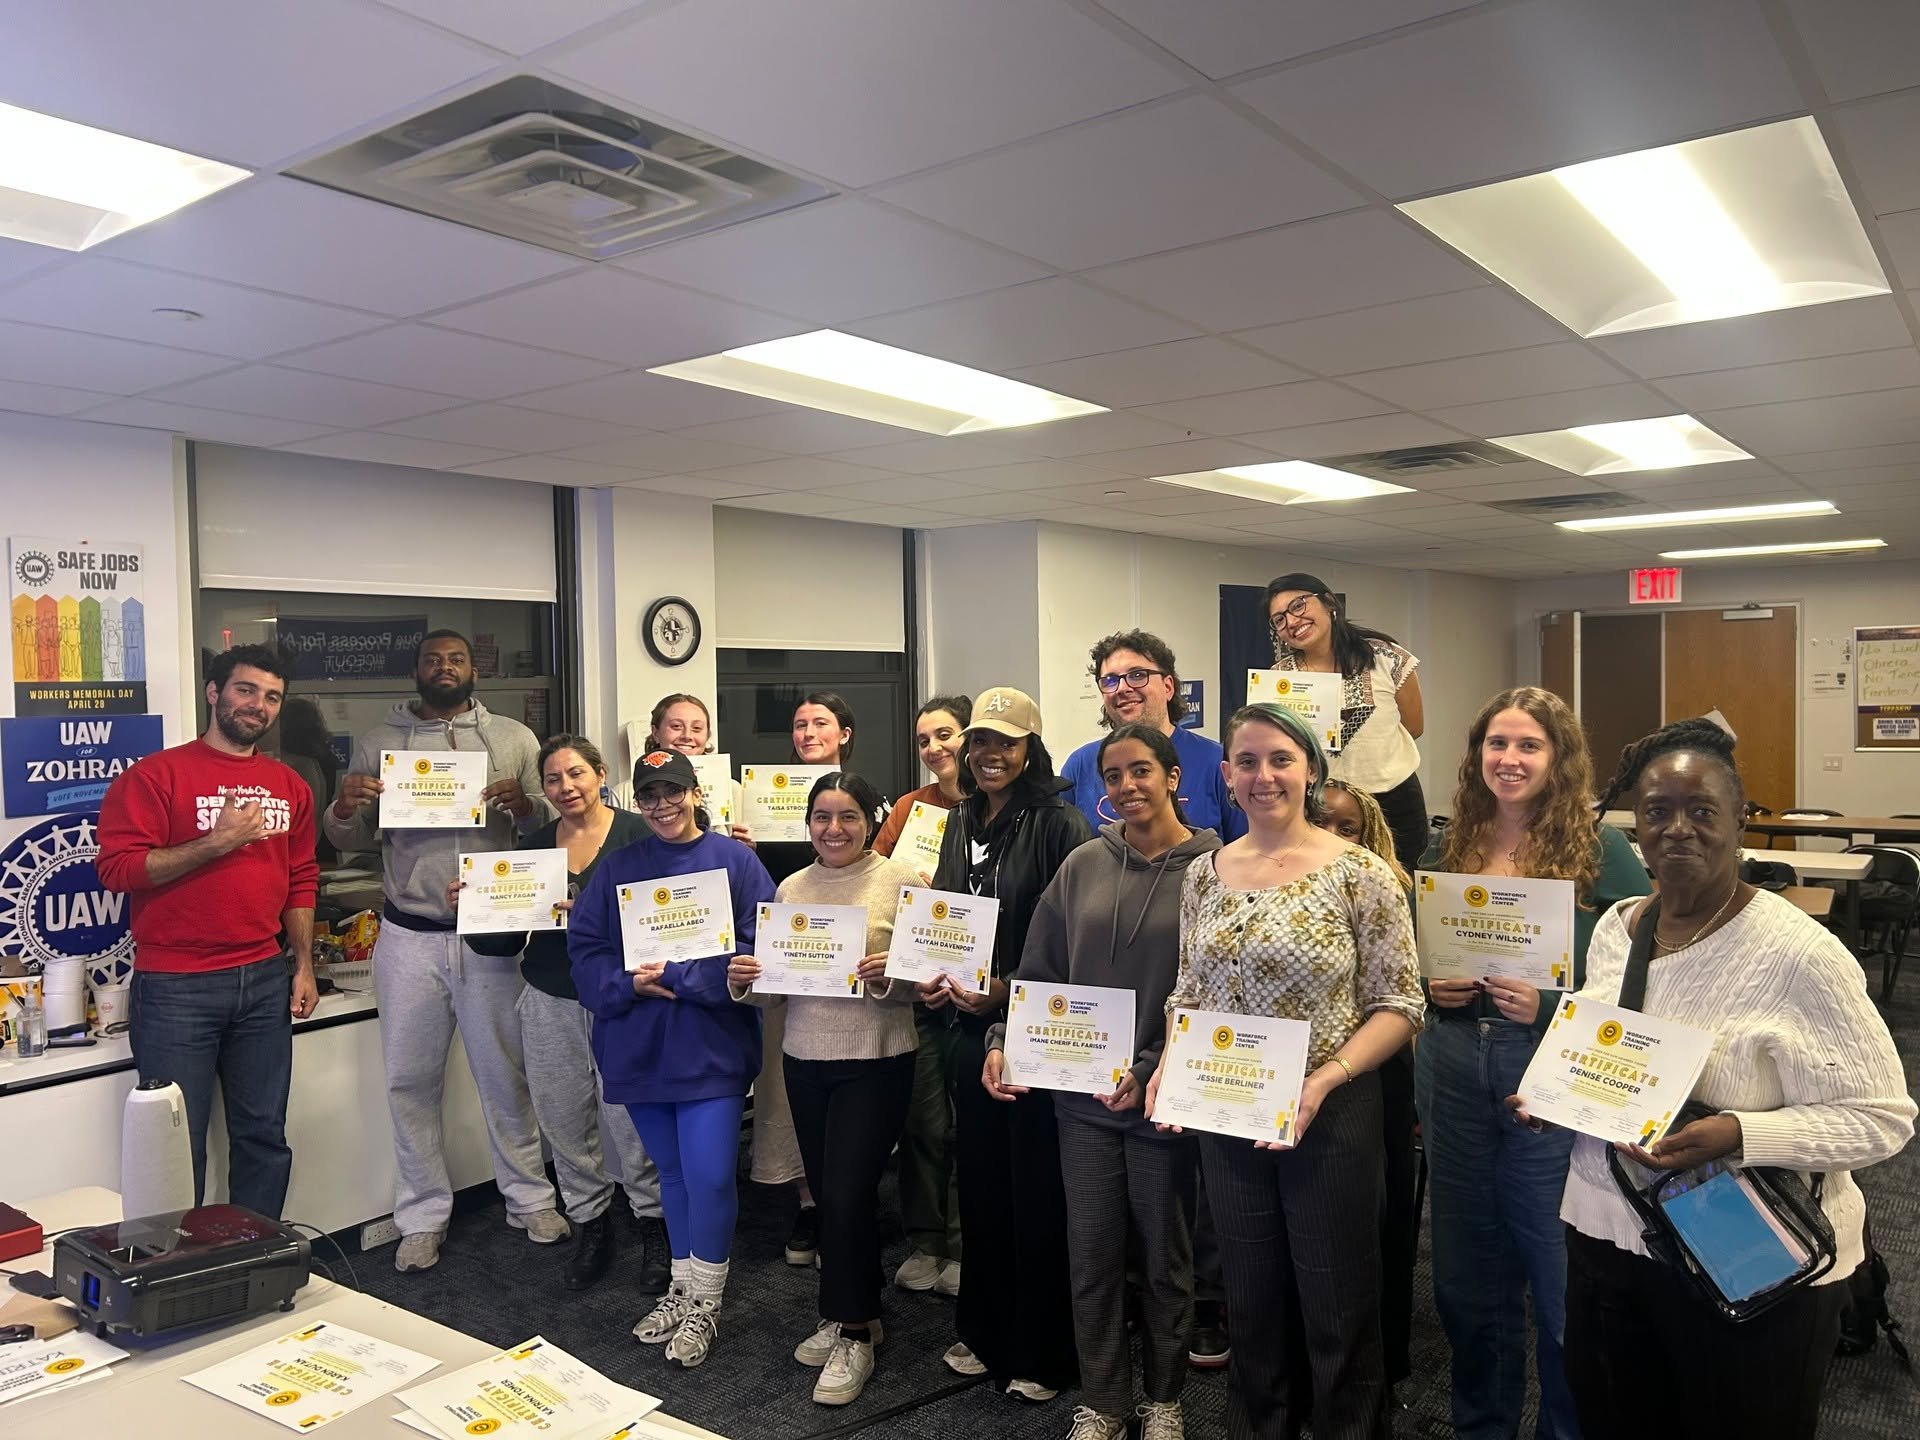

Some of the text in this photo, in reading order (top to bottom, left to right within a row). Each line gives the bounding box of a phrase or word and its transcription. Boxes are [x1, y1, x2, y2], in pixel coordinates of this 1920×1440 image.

[26, 564, 43, 573] UAW
[57, 551, 139, 572] SAFE JOBS
[80, 572, 117, 590] NOW
[1636, 569, 1678, 600] EXIT
[30, 689, 134, 699] WORKERS MEMORIAL DAY
[68, 700, 92, 709] APRIL
[60, 720, 112, 746] UAW
[53, 792, 70, 802] VOTE
[48, 854, 64, 866] AND
[23, 864, 47, 901] AEROSPACE
[476, 882, 546, 894] CERTIFICATE
[45, 890, 124, 932] UAW
[638, 908, 710, 925] CERTIFICATE
[651, 918, 704, 932] RAFAELLA ABEO
[1440, 917, 1542, 935] CERTIFICATE
[912, 926, 976, 944] CERTIFICATE
[1456, 930, 1532, 944] CYDNEY WILSON
[772, 941, 843, 952] CERTIFICATE
[915, 938, 974, 952] ALIYAH DAVENPORT
[1026, 1025, 1108, 1042] CERTIFICATE
[1236, 1032, 1268, 1041] WORKFORCE
[1626, 1030, 1661, 1045] WORKFORCE
[1081, 1042, 1106, 1050] FARISSY
[1621, 1040, 1644, 1051] CENTER
[1624, 1036, 1650, 1048] TRAINING
[1186, 1059, 1276, 1080] CERTIFICATE
[1560, 1048, 1660, 1087] CERTIFICATE
[1196, 1074, 1265, 1090] JESSIE BERLINER
[1570, 1066, 1602, 1082] DENISE
[1602, 1077, 1641, 1095] COOPER
[266, 1360, 353, 1396] CERTIFICATE
[320, 1368, 350, 1382] KAREN
[478, 1380, 552, 1430] CERTIFICATE
[500, 1379, 555, 1416] KATRINA TOMER
